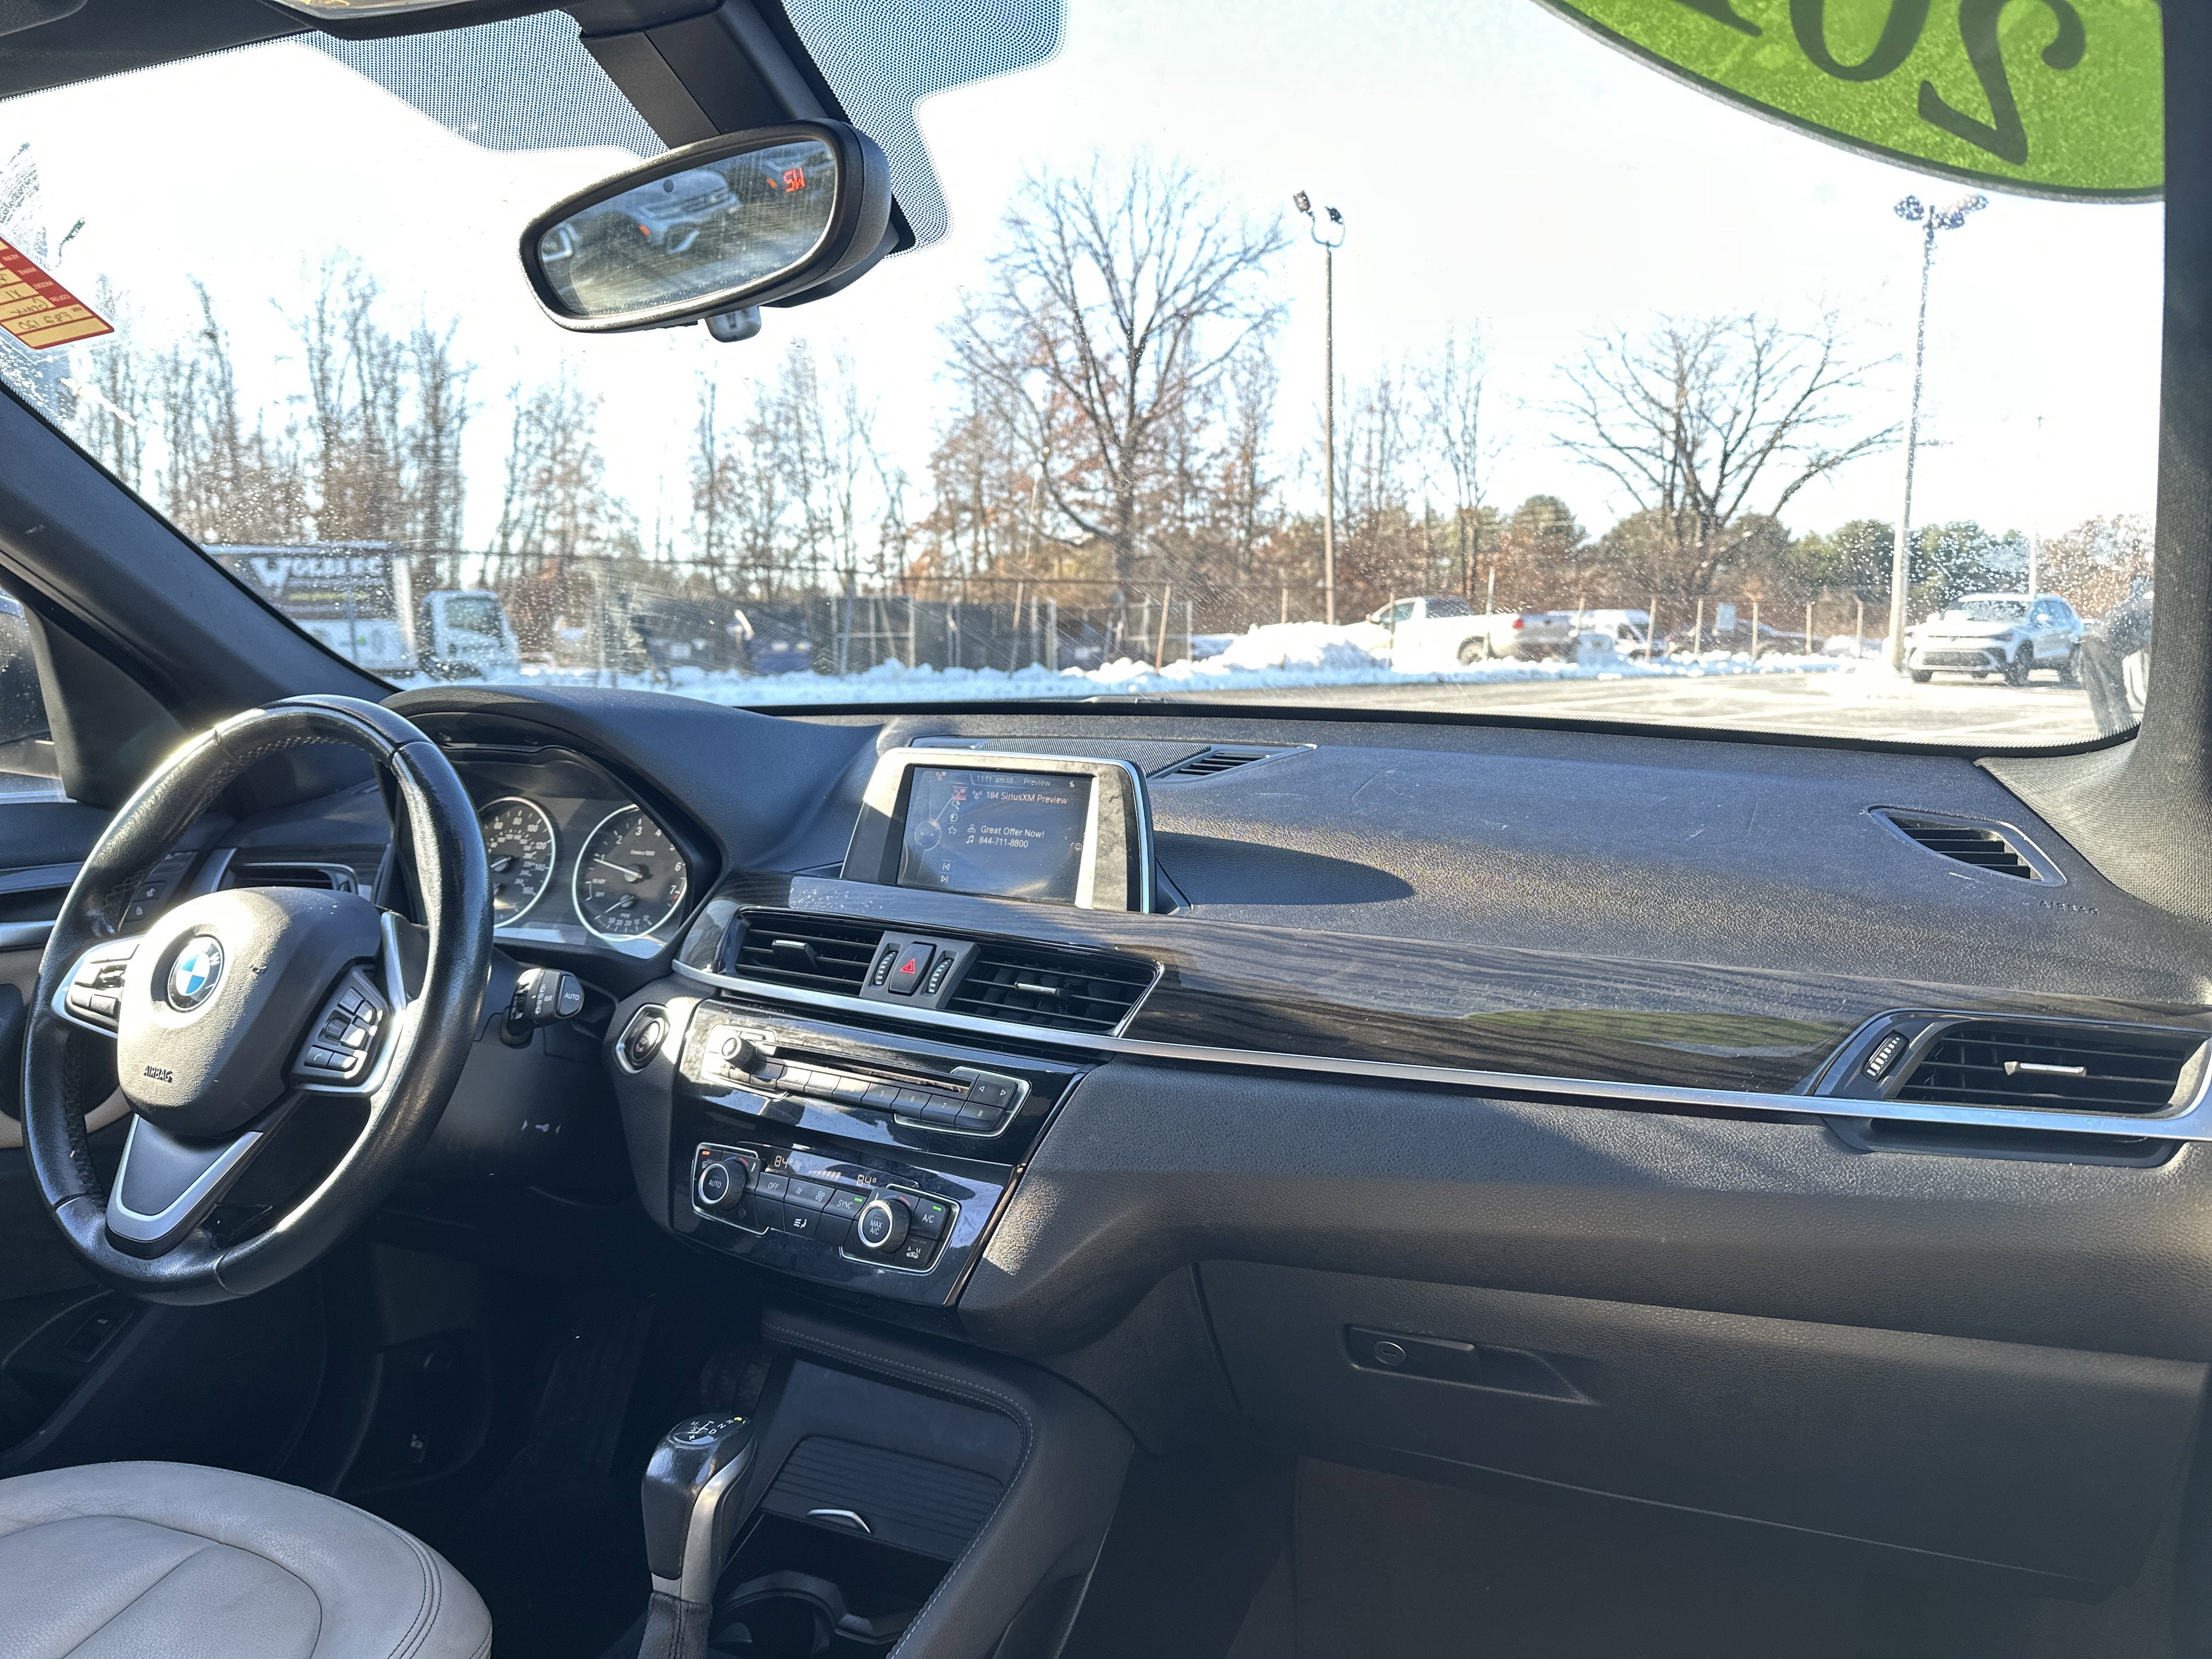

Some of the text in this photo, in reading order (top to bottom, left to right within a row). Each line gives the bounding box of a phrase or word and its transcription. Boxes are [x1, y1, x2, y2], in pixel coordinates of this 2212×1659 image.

[1024, 778, 1051, 787] Preview
[986, 791, 1068, 804] 184 SiriusXM Preview
[527, 824, 538, 832] 100
[635, 826, 643, 836] 3
[654, 828, 662, 837] 4
[981, 825, 1044, 838] Great Offer Now!
[615, 834, 623, 845] 2
[979, 836, 1029, 848] 844-711-8800
[535, 842, 547, 850] 120
[675, 861, 681, 871] 6
[669, 885, 677, 894] 7
[564, 992, 580, 1001] AUTO
[143, 1065, 173, 1084] AIRBAG
[708, 1180, 722, 1188] AUTO
[768, 1182, 779, 1190] OFF
[837, 1199, 853, 1209] SYNC
[922, 1214, 934, 1223] A/C
[870, 1220, 883, 1229] MAX
